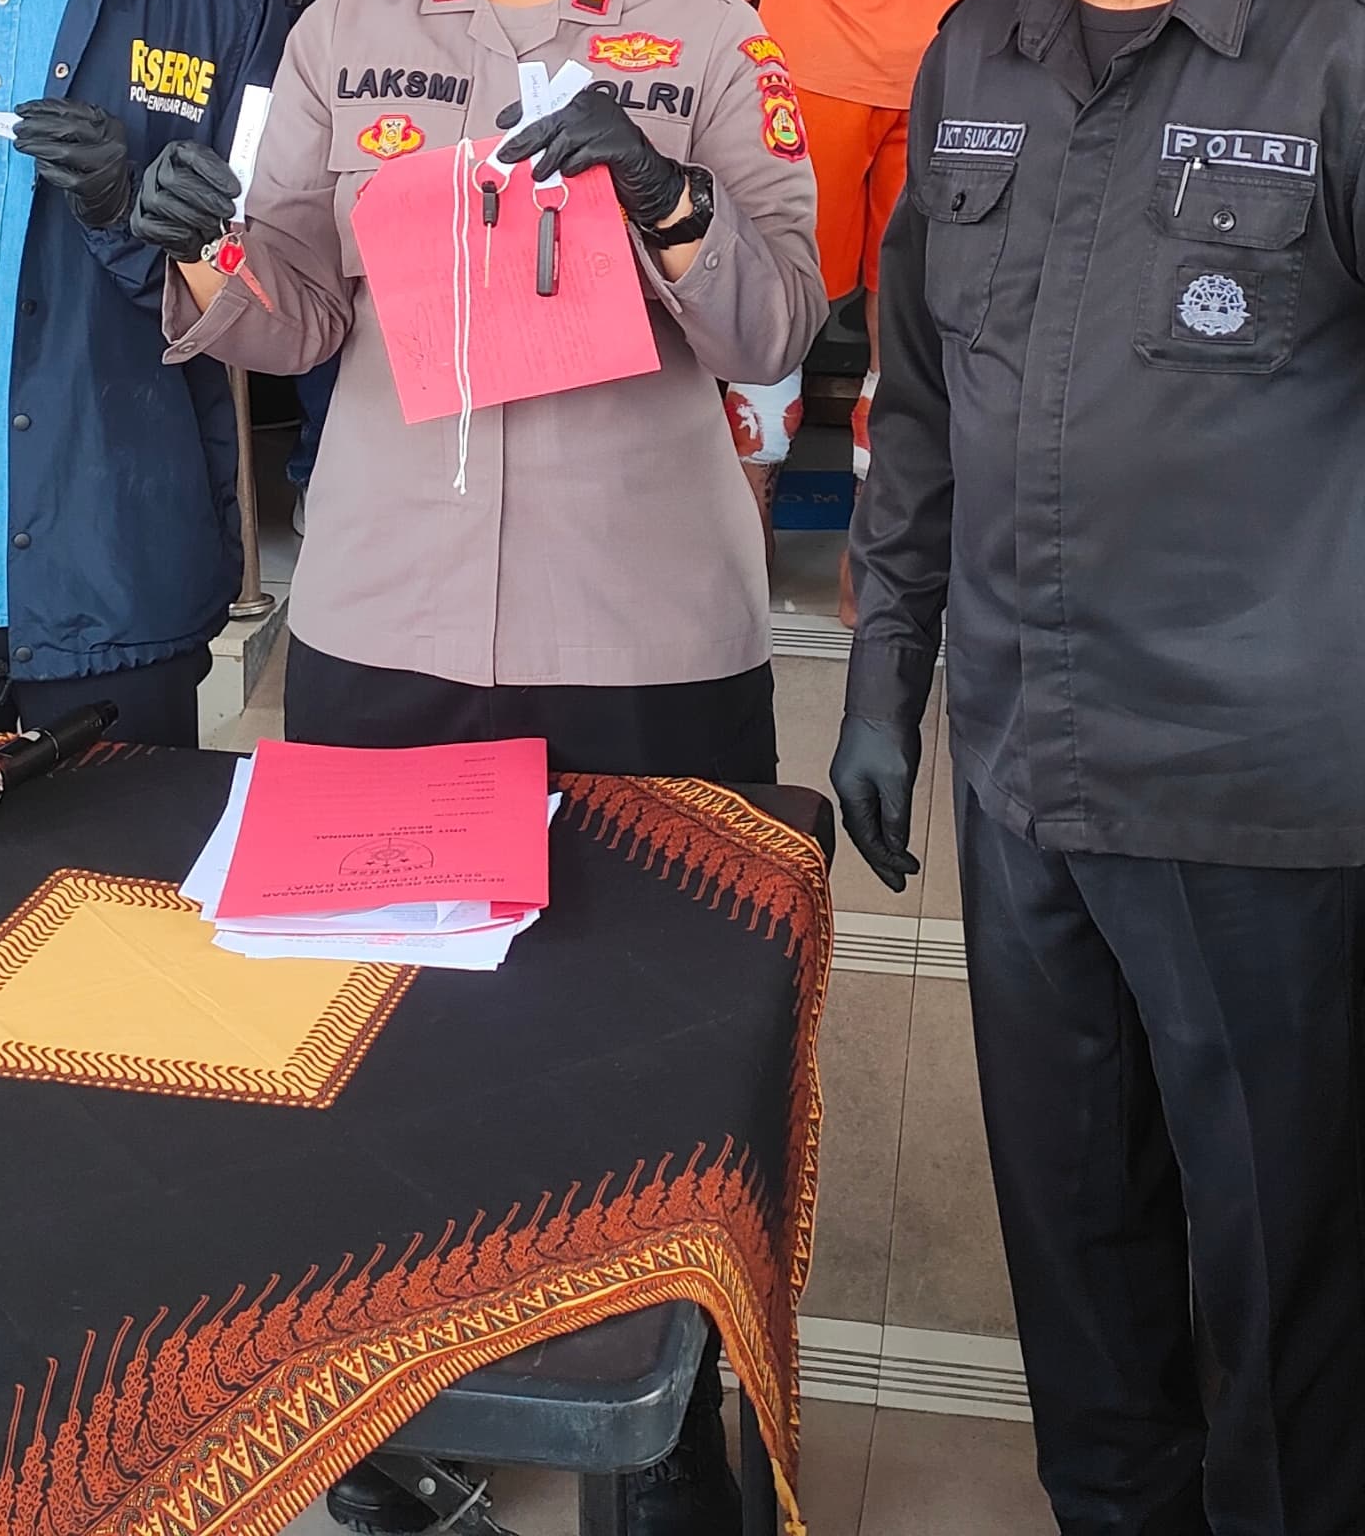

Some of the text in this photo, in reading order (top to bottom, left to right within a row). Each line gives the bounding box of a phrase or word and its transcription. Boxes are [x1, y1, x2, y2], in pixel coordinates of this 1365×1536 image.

[131, 39, 216, 106] RSERSE
[337, 67, 469, 106] LAKSMI
[585, 80, 695, 119] OLRI
[943, 127, 1019, 150] KT SUKADI
[1174, 131, 1305, 167] POLRI
